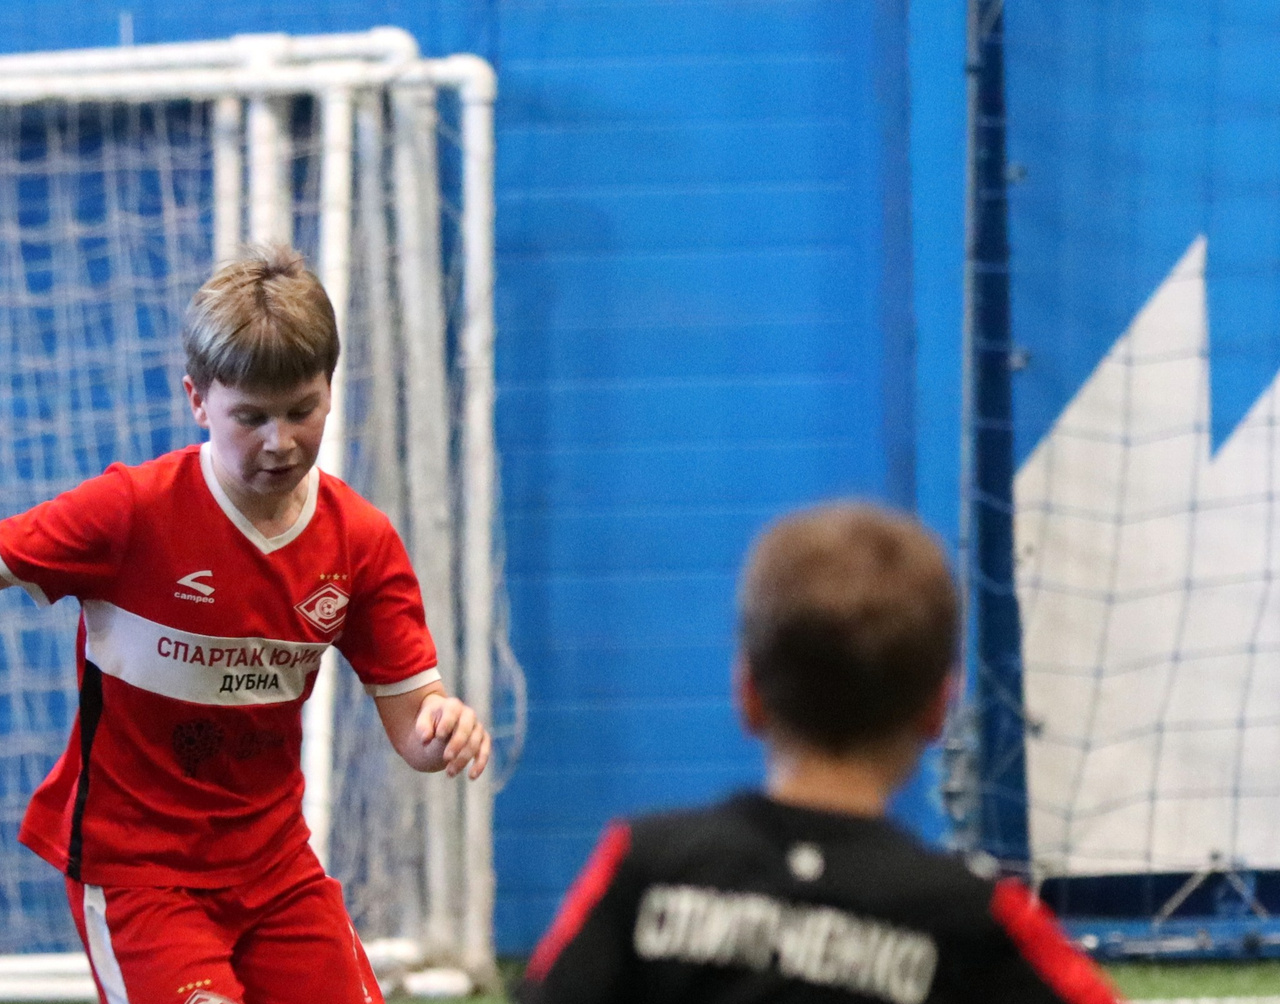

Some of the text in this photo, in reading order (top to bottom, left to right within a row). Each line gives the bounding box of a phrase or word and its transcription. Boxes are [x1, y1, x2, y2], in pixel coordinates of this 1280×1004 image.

[174, 592, 215, 604] campeo
[157, 636, 324, 668] СПАРТАК ЮНИ
[219, 673, 279, 693] ДУБНА
